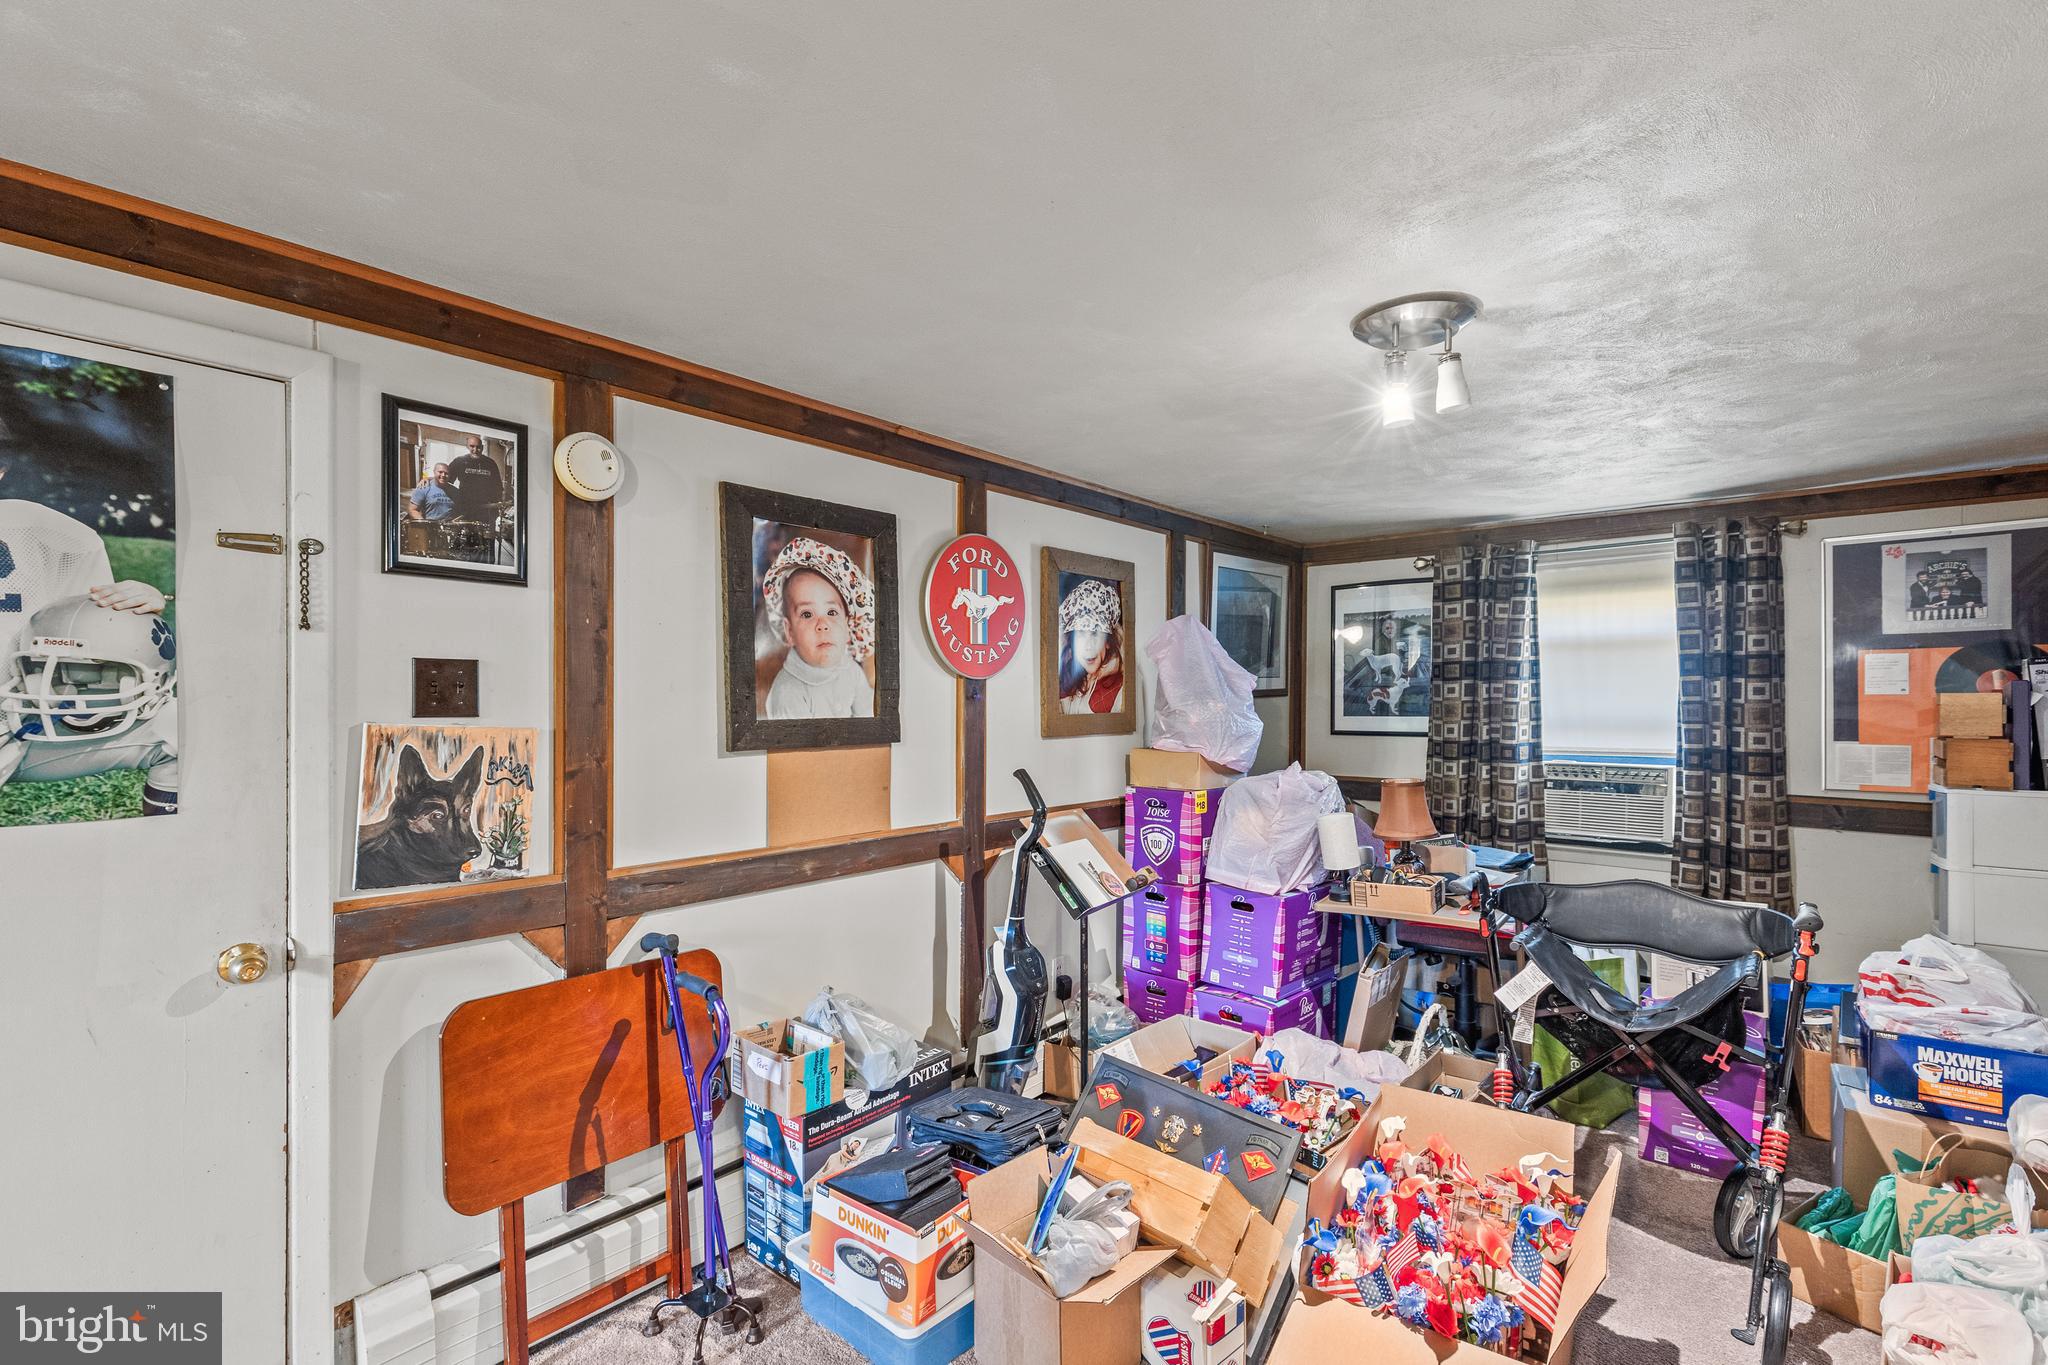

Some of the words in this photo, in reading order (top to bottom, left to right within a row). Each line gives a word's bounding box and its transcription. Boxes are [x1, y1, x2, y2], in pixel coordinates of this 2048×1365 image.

[947, 547, 1008, 578] FORD
[44, 638, 75, 647] Riddell
[937, 613, 1020, 664] MUSTANG
[1918, 1046, 2003, 1073] MAXWELL
[909, 1058, 950, 1088] INTEX
[1943, 1065, 2003, 1088] HOUSE
[1874, 1094, 1892, 1106] 84
[808, 1125, 820, 1136] The
[872, 1090, 900, 1109] Advantage
[838, 1205, 890, 1243] DUNKIN'
[811, 1260, 822, 1273] 72
[880, 1268, 906, 1287] ORIGINAL
[884, 1276, 902, 1290] BLEND
